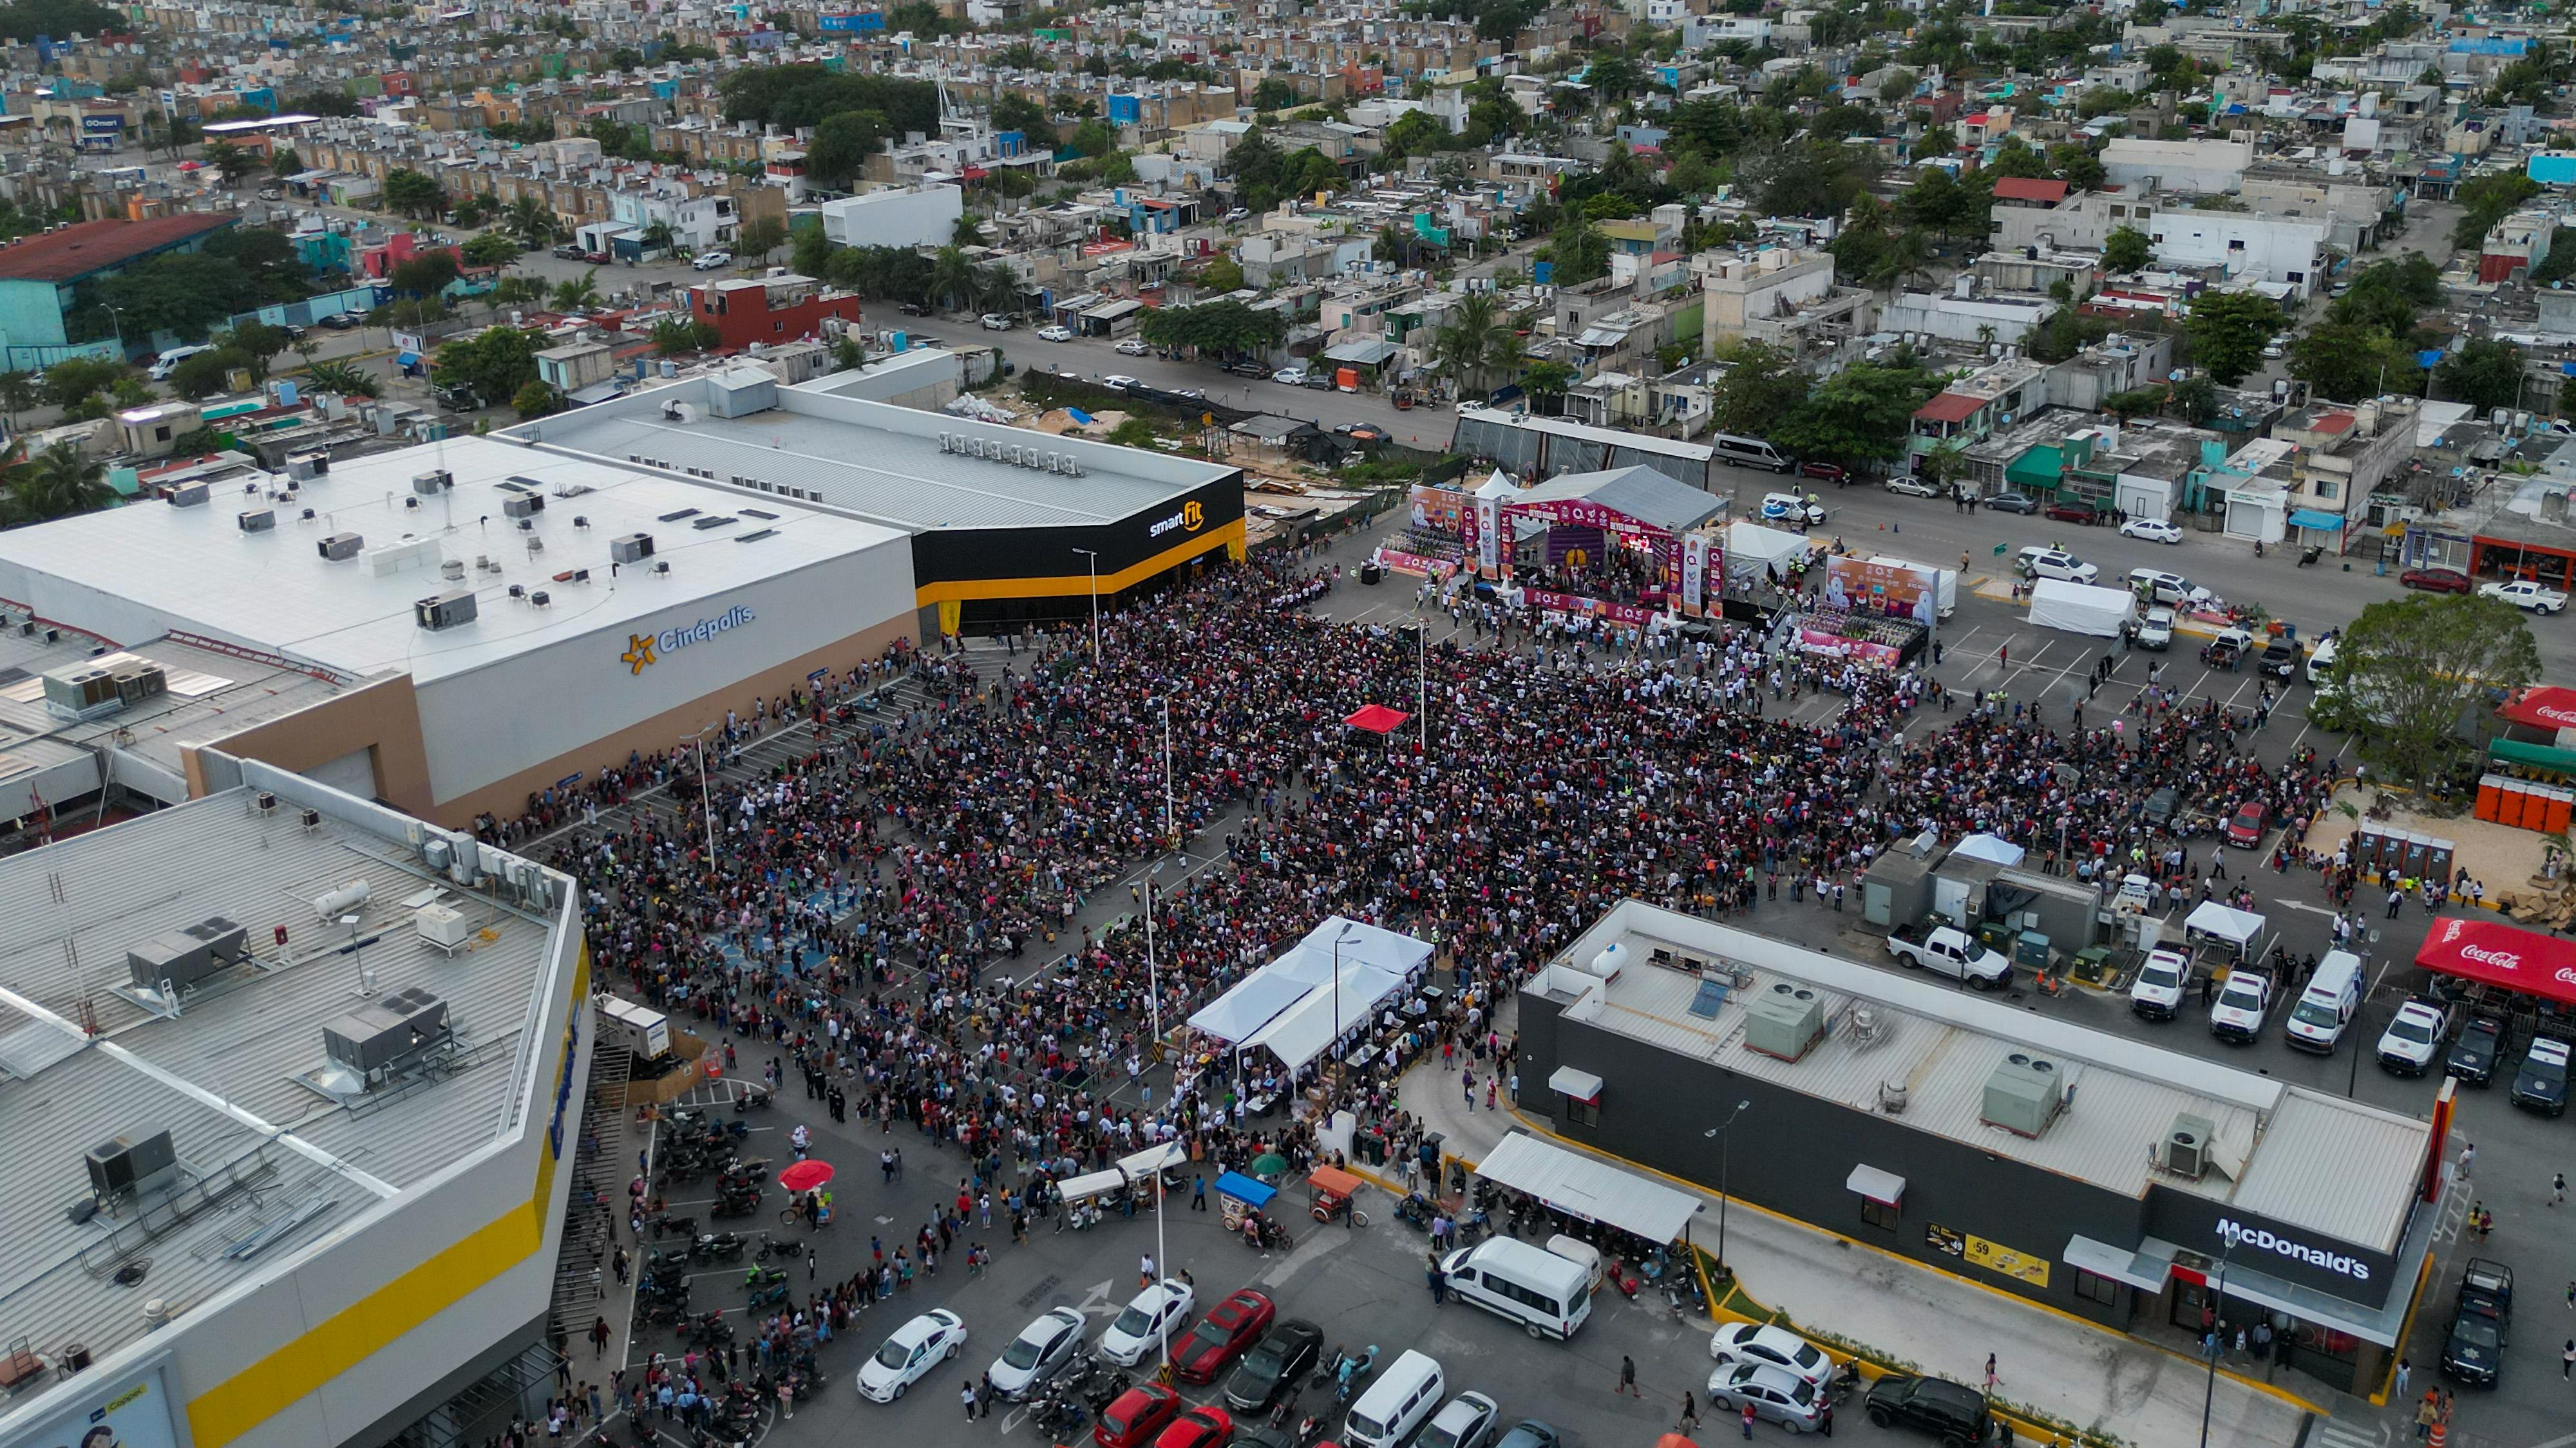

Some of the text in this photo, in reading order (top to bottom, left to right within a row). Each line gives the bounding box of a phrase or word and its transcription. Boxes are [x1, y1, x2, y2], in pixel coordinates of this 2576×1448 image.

[1150, 512, 1184, 538] smart
[659, 605, 754, 653] Cinépolis
[2215, 1218, 2370, 1280] McDonald's
[109, 1387, 142, 1411] Coppel
